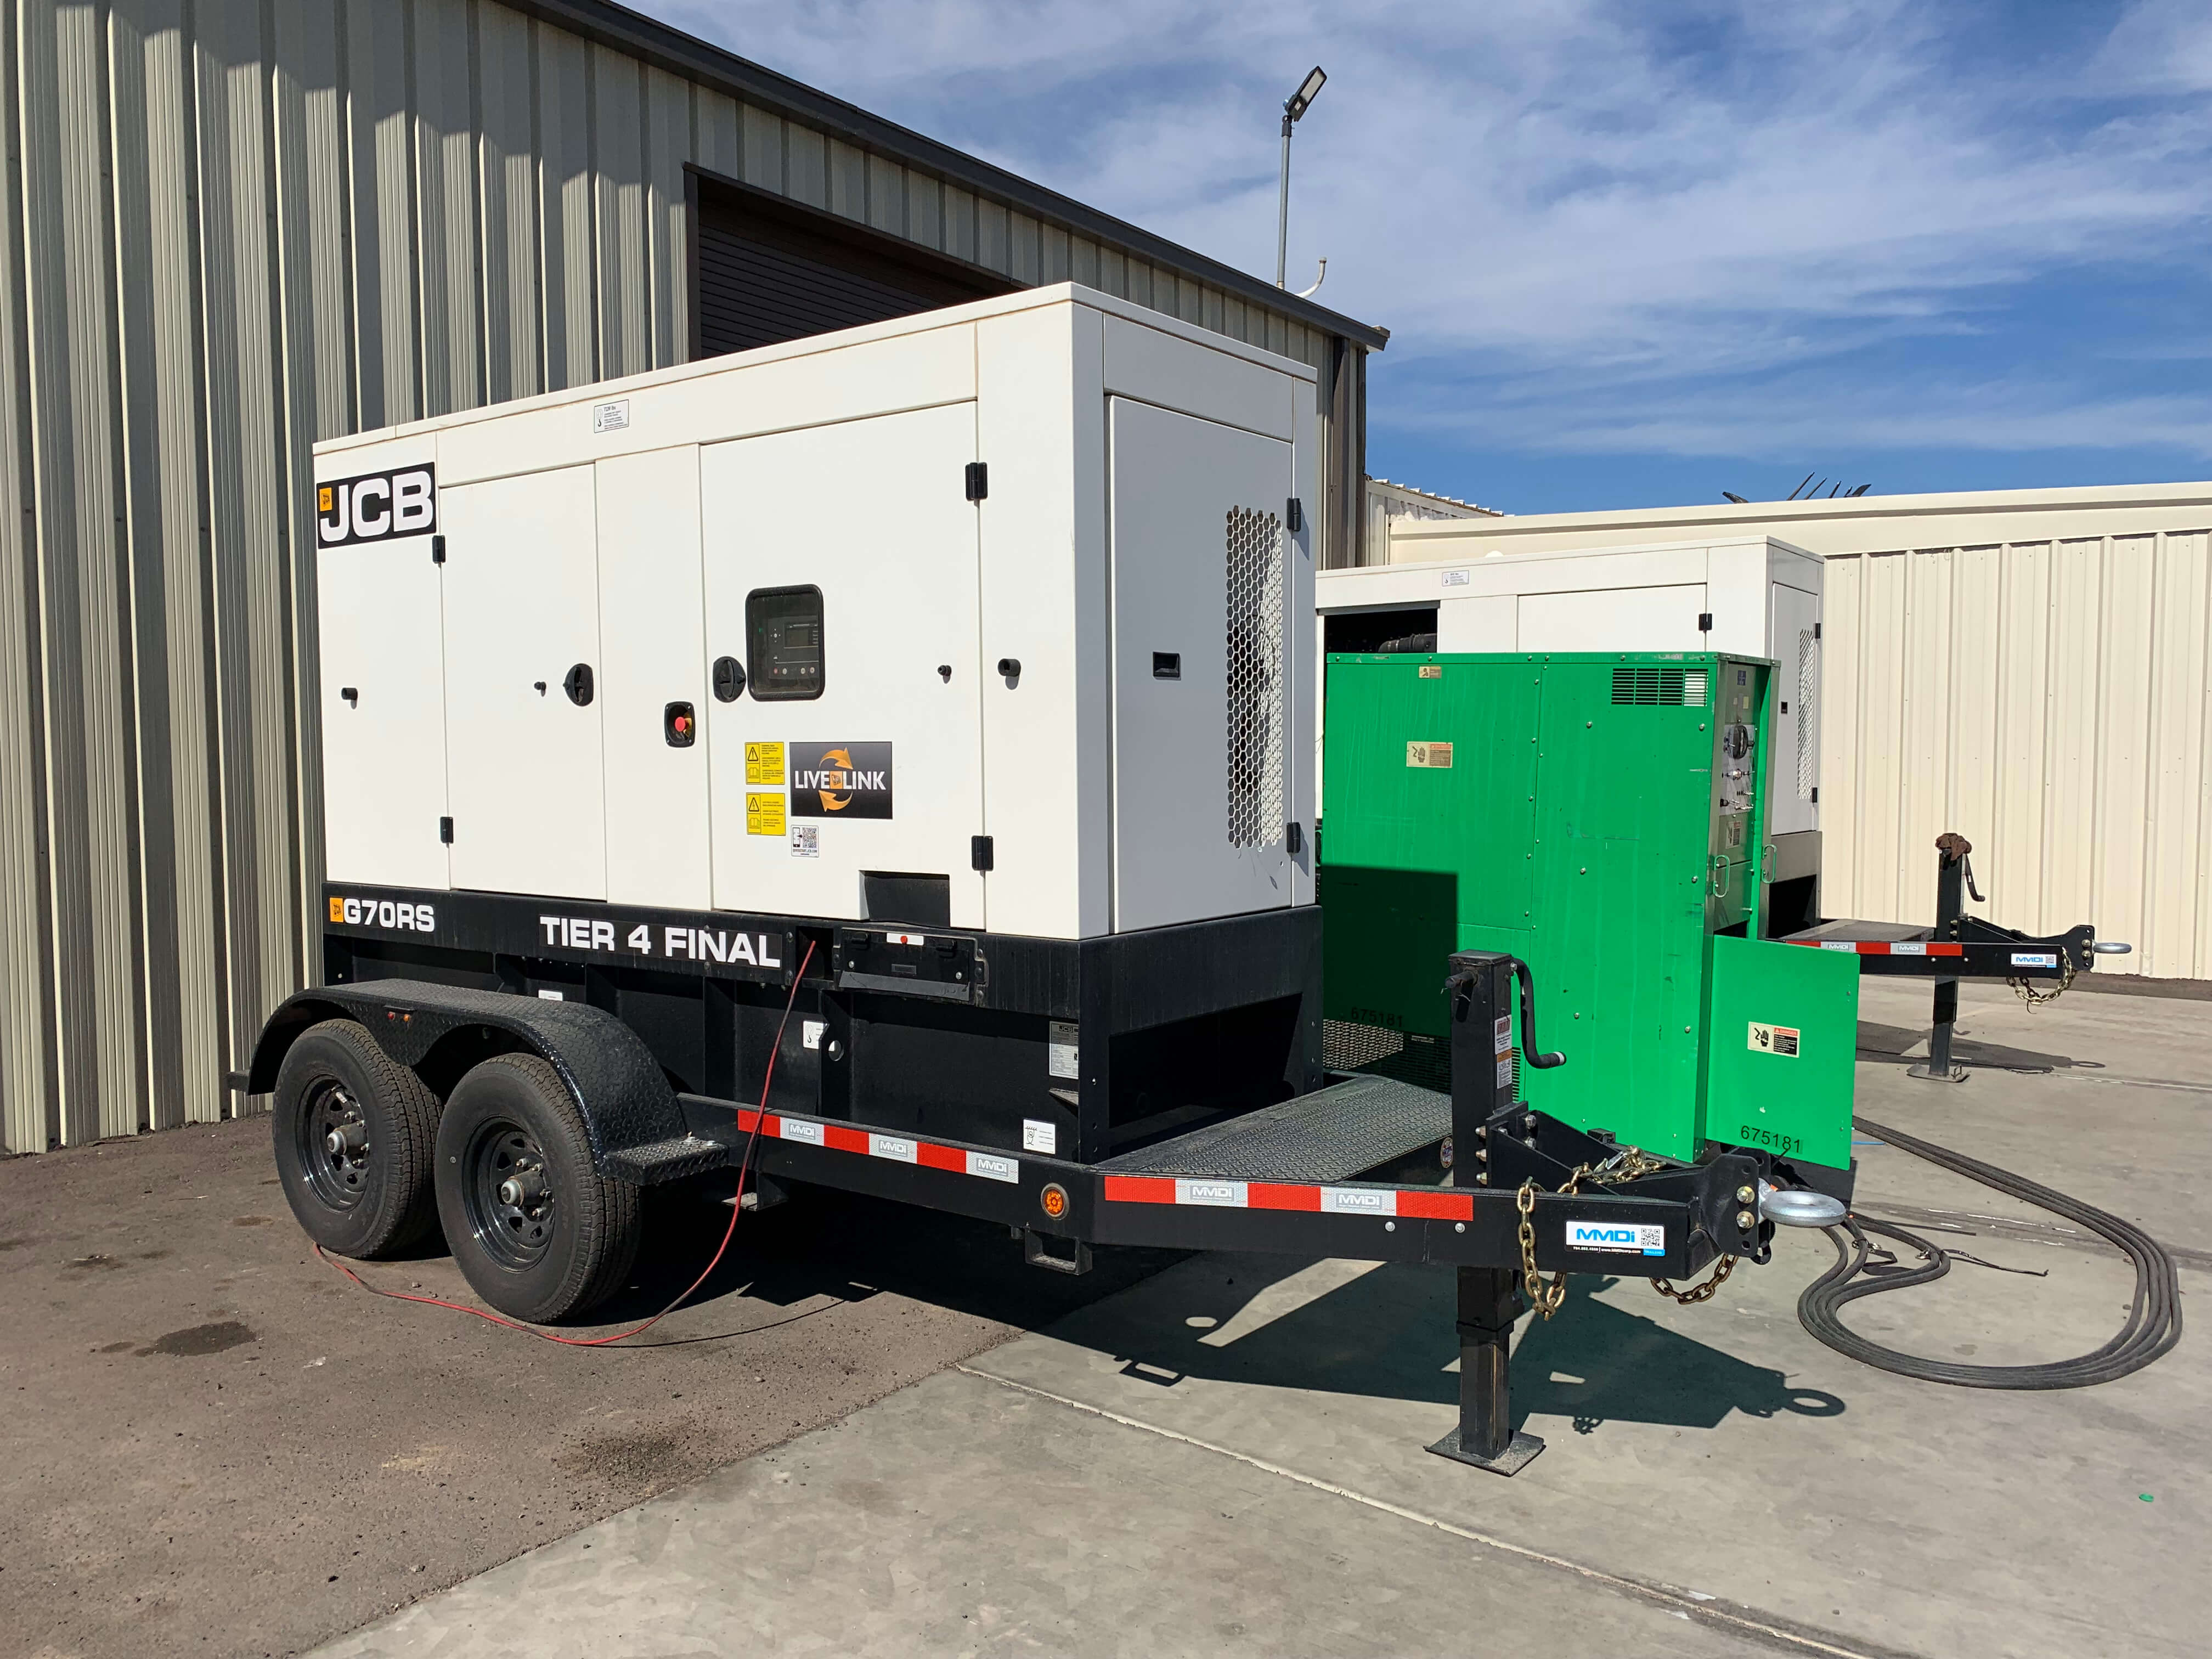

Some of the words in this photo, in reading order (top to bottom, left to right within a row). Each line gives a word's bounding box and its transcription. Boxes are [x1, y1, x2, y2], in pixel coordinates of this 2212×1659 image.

[320, 470, 433, 542] JCB
[794, 770, 830, 789] LIVE
[842, 771, 886, 790] LINK
[343, 898, 435, 932] G70RS
[539, 916, 615, 952] TIER
[628, 925, 651, 955] 4
[664, 927, 781, 968] FINAL
[1351, 1006, 1403, 1028] 675181
[1740, 1125, 1800, 1153] 675181
[1576, 1228, 1635, 1243] MMDi
